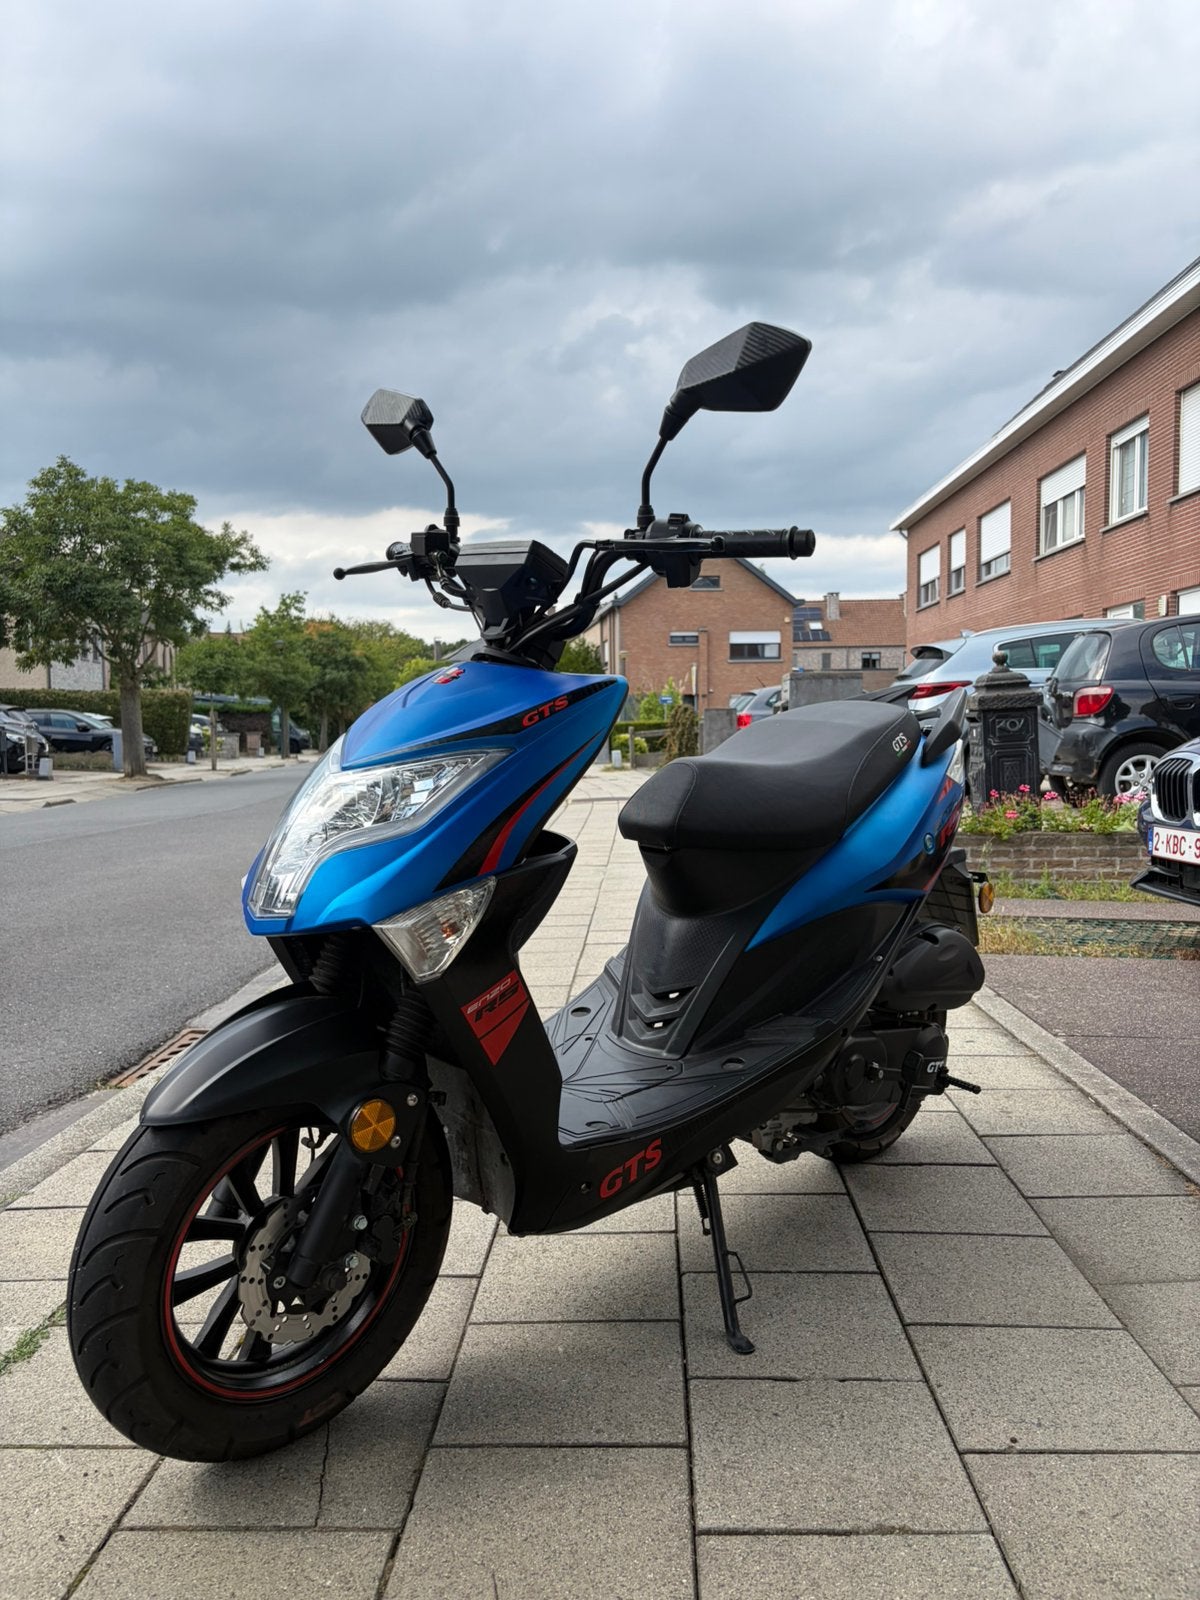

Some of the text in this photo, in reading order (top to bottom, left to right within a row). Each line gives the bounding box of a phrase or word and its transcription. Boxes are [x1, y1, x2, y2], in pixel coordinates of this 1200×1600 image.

[522, 695, 569, 728] GTS
[892, 732, 908, 752] GTS
[1154, 831, 1200, 859] 2-KBC-9
[600, 1137, 663, 1199] GTS
